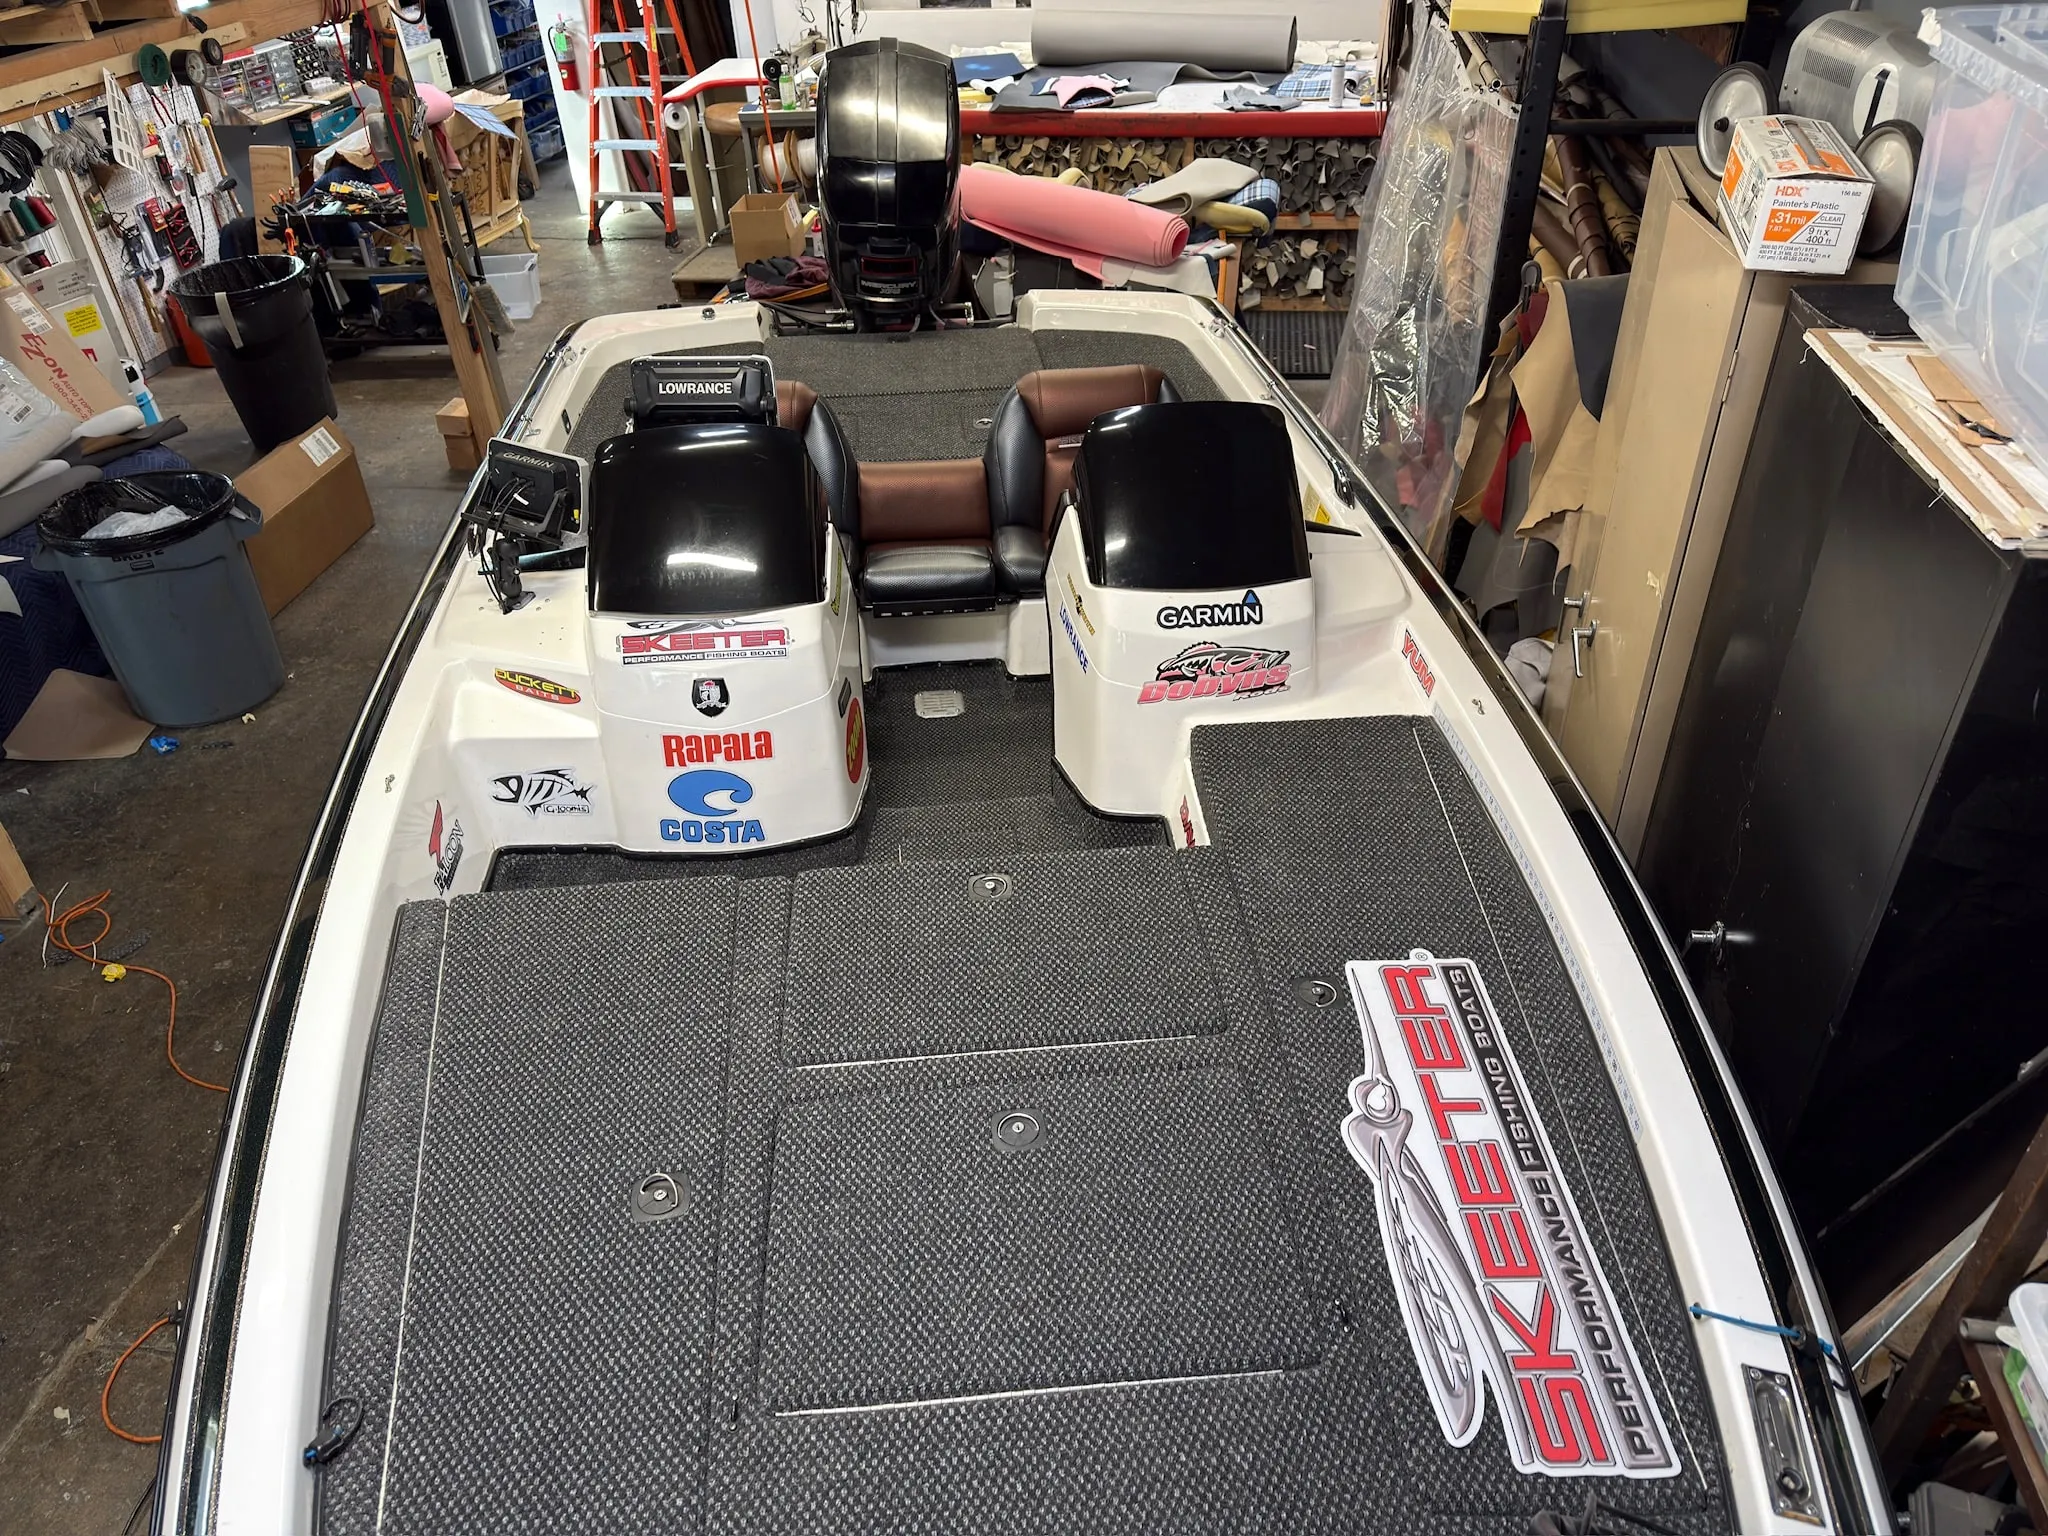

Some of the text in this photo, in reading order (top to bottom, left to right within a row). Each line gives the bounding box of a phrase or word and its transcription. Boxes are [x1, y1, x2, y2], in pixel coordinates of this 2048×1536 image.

[1776, 186, 1802, 197] HDX
[1772, 199, 1840, 210] Painter's Plastic
[1806, 236, 1823, 244] 400
[1808, 227, 1814, 235] 9
[861, 280, 916, 289] MERCURY
[62, 380, 79, 398] AUTO
[658, 382, 732, 395] LOWRANCE
[503, 452, 555, 469] GARMIN
[1157, 603, 1263, 628] GARMIN
[621, 629, 786, 654] SKEETER
[1059, 602, 1089, 675] LOWRANCE
[624, 653, 704, 664] PERFORMANCE
[706, 650, 748, 659] FISHING
[1402, 628, 1436, 698] YUM
[495, 668, 577, 698] DUCKETT
[515, 684, 559, 700] BAITS
[1137, 664, 1291, 704] Dobyns
[1233, 685, 1291, 701] Rods
[662, 731, 773, 767] Rapala
[660, 819, 765, 843] COSTA
[434, 819, 464, 896] FALCON
[1380, 965, 1615, 1466] SKEETER
[1450, 968, 1654, 1456] PERFORMANCE FISHING BOATS
